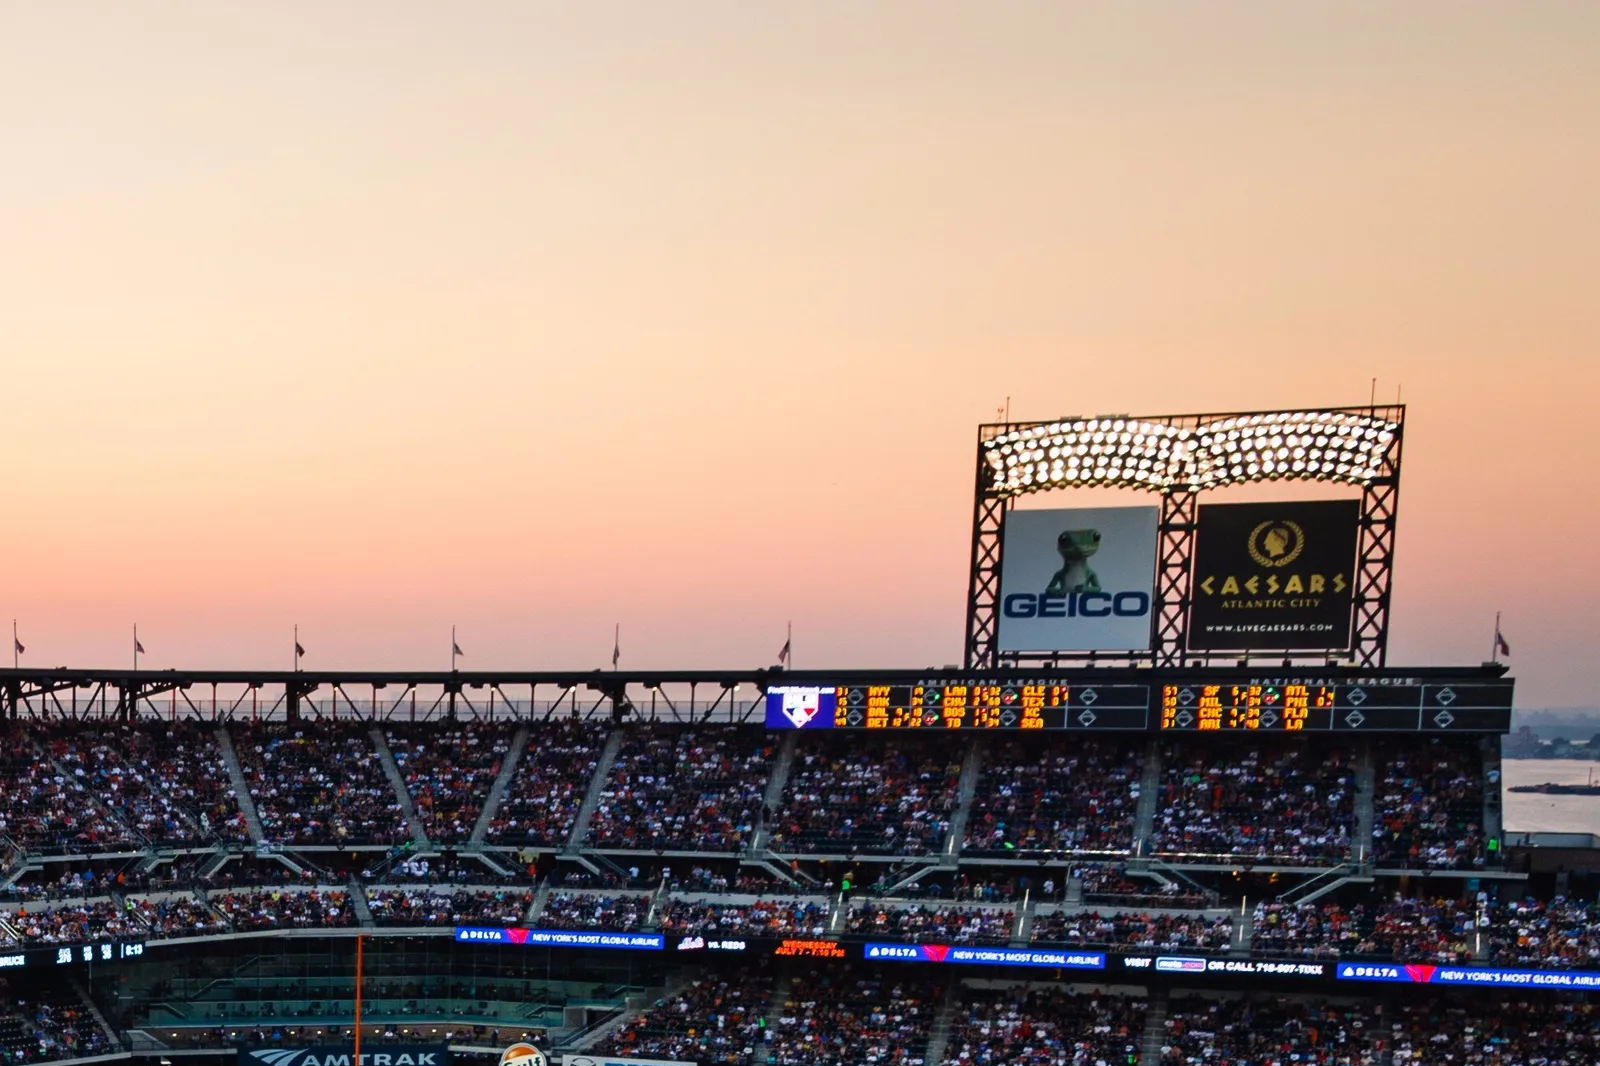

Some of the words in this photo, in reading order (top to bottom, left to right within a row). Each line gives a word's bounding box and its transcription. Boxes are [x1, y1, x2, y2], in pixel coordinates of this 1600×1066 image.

[1200, 573, 1347, 595] CAESARS
[1004, 591, 1149, 618] GEICO
[1221, 600, 1285, 608] ATLANTIC
[1290, 599, 1321, 608] CITY
[1206, 624, 1333, 632] WWW.LIVECAESARS.COM
[868, 686, 890, 696] NYY
[1023, 686, 1046, 696] CLE
[1204, 686, 1220, 696] SF
[1286, 686, 1309, 696] ATL
[868, 697, 890, 706] OAK
[1022, 697, 1045, 706] TEX
[1200, 697, 1222, 706] MIL
[867, 707, 888, 717] BAL
[943, 707, 965, 717] BOS
[1025, 708, 1040, 717] KC
[1200, 708, 1223, 718] CHC
[1284, 708, 1307, 718] FLA
[866, 718, 888, 728] DET
[946, 718, 961, 728] TB
[1022, 718, 1043, 728] SEA
[1286, 719, 1303, 729] LA
[470, 931, 501, 939] DELTA
[533, 934, 551, 942] NEW
[552, 934, 577, 943] YORK'S
[578, 935, 600, 944] MOST
[601, 936, 629, 945] GLOBAL
[630, 938, 659, 946] AIRLINE
[708, 941, 720, 949] vs.
[721, 941, 745, 950] REDS
[782, 940, 838, 949] WEDNESDAY
[775, 947, 796, 956] JULY
[831, 949, 845, 957] PM
[881, 947, 917, 957] DELTA
[953, 951, 974, 960] NEW
[975, 951, 1004, 961] YORK'S
[1006, 953, 1031, 962] MOST
[1032, 953, 1065, 963] GLOBAL
[1067, 955, 1099, 966] AIRLINE
[1125, 958, 1151, 967] VISIT
[1208, 961, 1225, 970] OR
[1226, 962, 1255, 971] CALL
[1356, 967, 1398, 977] DELTA
[1440, 971, 1464, 981] NEW
[1466, 972, 1500, 982] YORK'S
[1501, 973, 1532, 983] MOST
[1533, 974, 1571, 985] GLOBAL
[301, 1053, 437, 1066] AMTRAK
